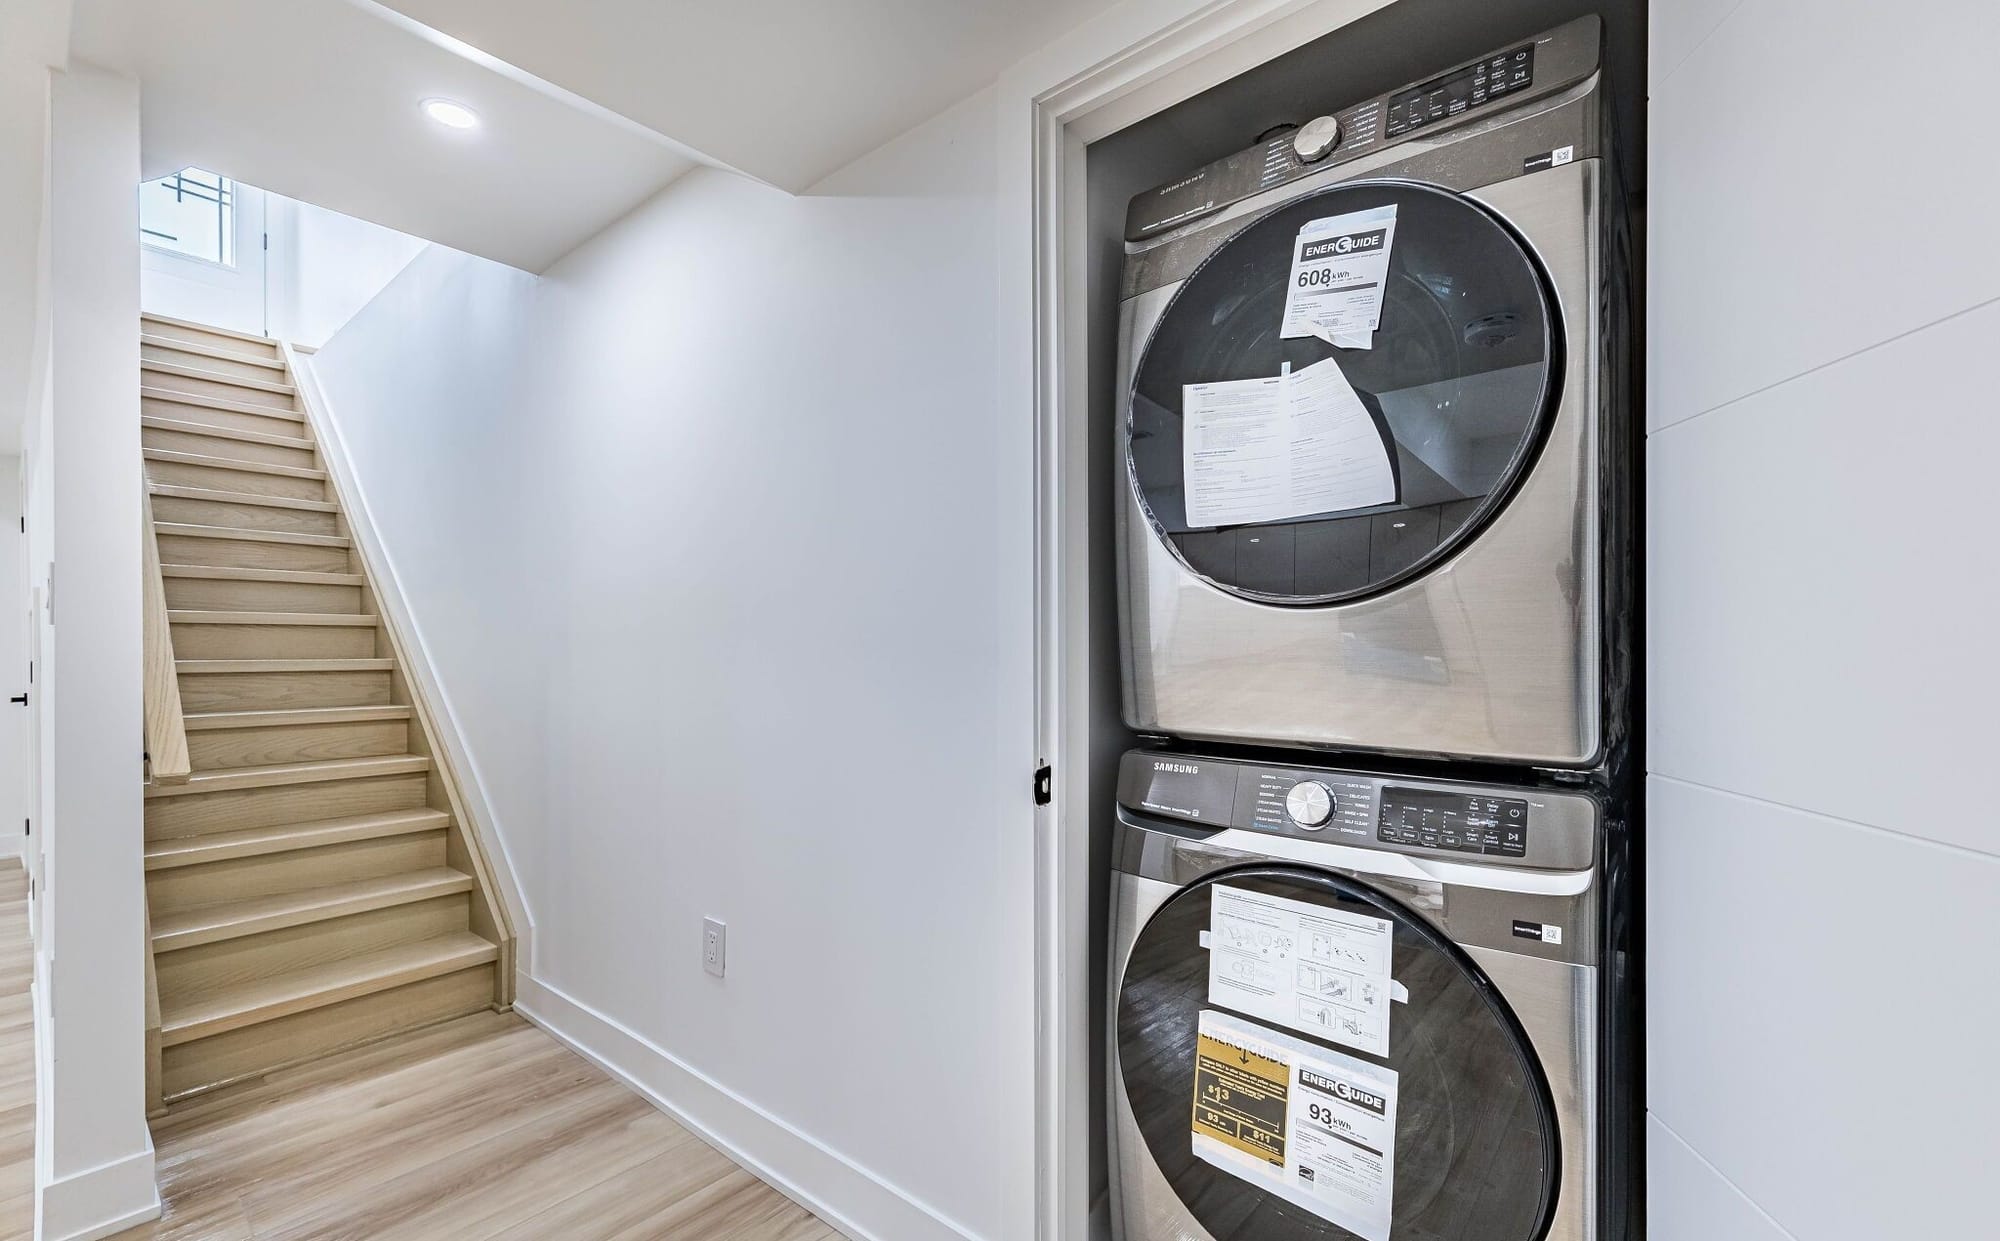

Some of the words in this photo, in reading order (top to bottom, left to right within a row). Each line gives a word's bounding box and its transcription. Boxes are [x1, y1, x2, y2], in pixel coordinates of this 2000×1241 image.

[1306, 235, 1380, 257] ENERGUIDE
[1298, 268, 1332, 288] 608
[1332, 271, 1350, 280] kWh
[1154, 762, 1199, 774] SAMSUNG
[1302, 1071, 1382, 1109] ENERGUIDE
[1309, 1103, 1332, 1125] 93
[1333, 1117, 1352, 1130] kWh
